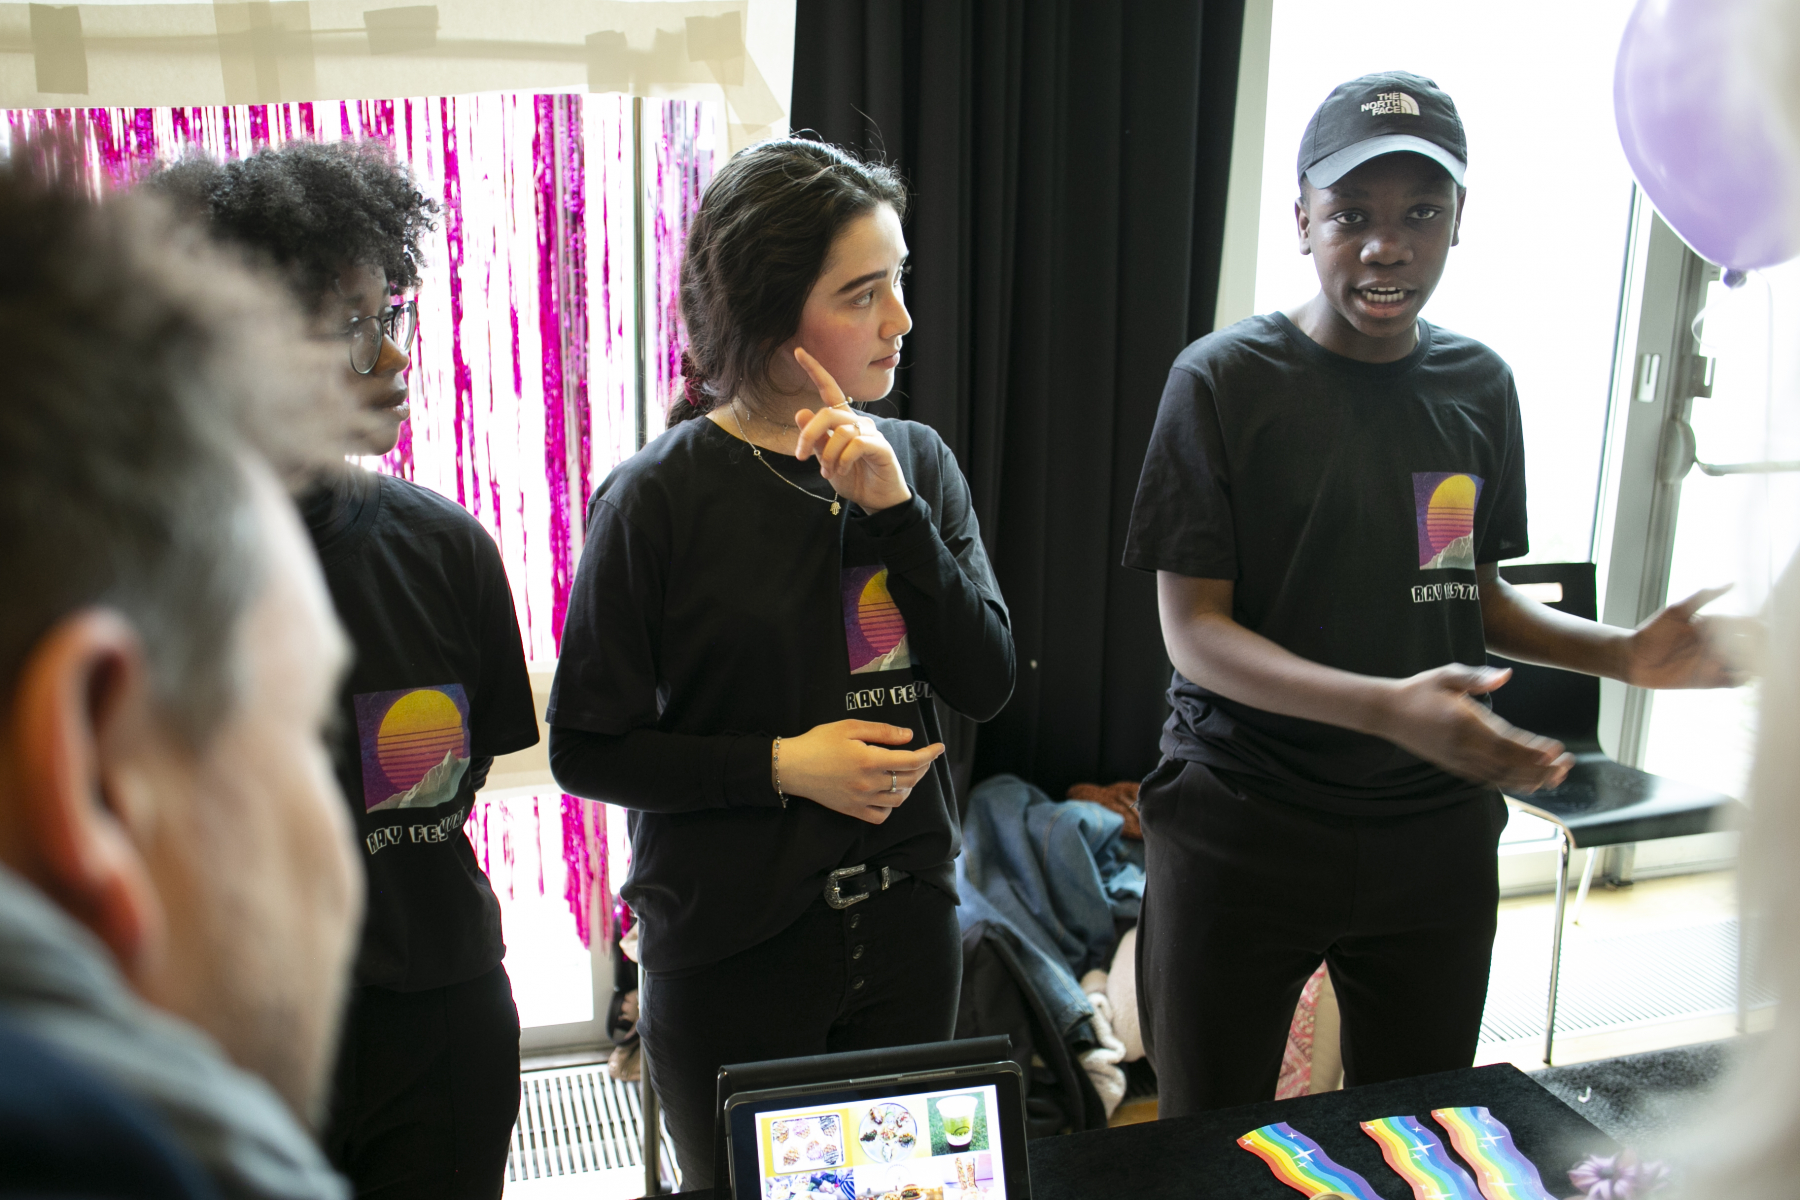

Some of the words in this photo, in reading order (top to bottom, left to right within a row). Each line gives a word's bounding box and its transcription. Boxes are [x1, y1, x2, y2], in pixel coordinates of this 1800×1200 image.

[1377, 92, 1400, 100] THE
[1361, 100, 1400, 112] NORTH
[1372, 106, 1401, 116] FACE
[1411, 583, 1442, 603] RAY
[845, 687, 885, 711] RAY
[366, 825, 402, 855] RAY
